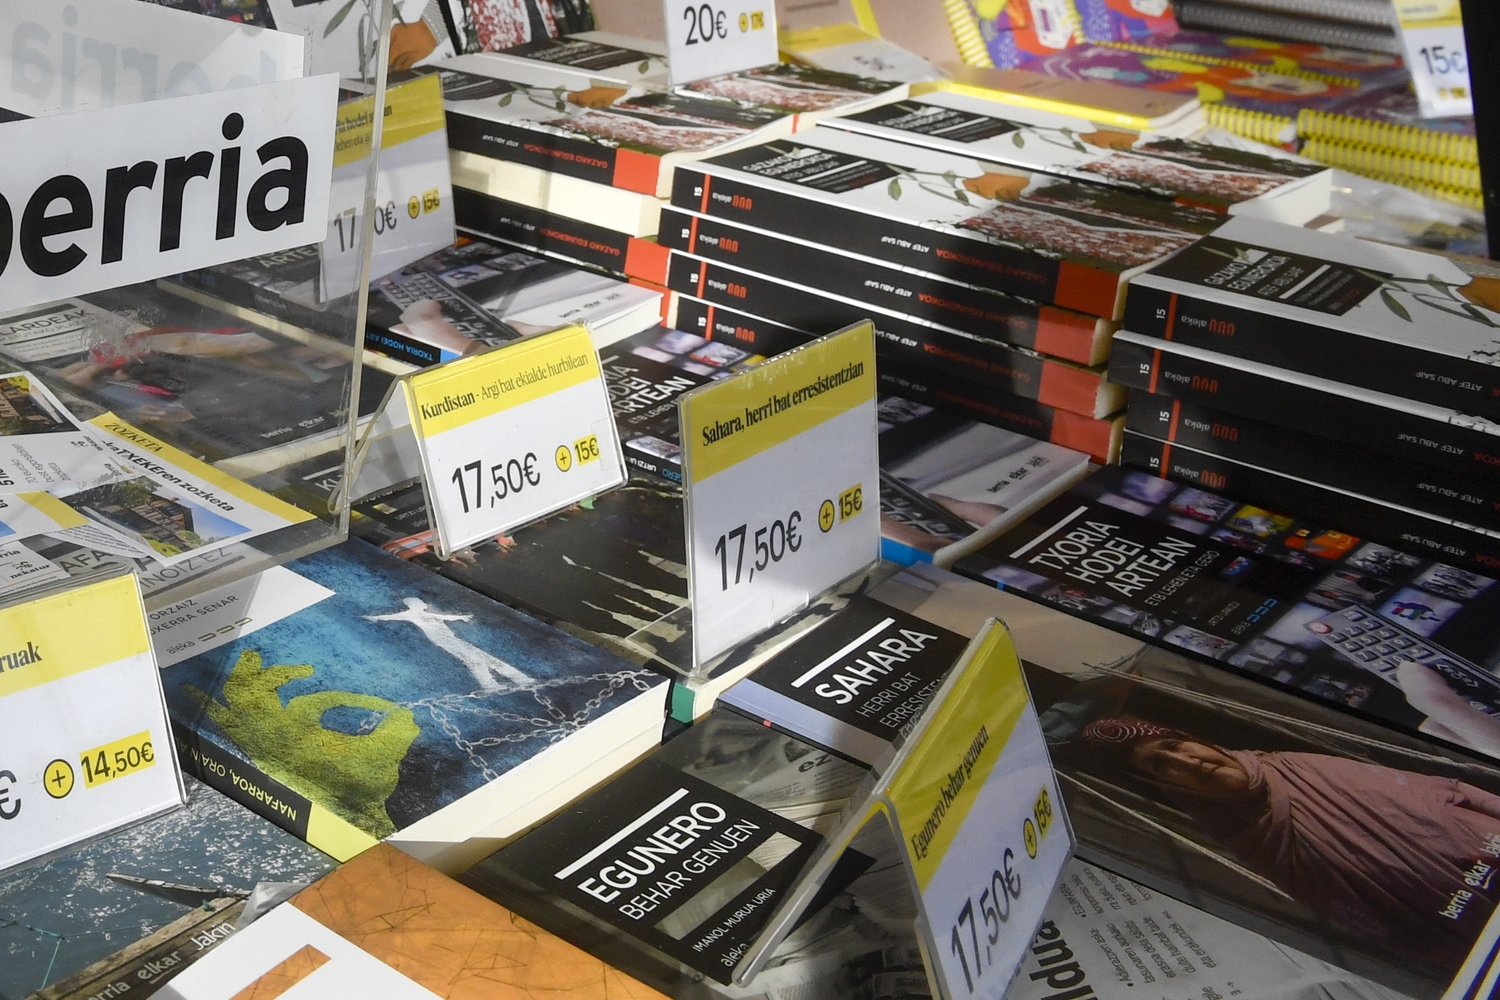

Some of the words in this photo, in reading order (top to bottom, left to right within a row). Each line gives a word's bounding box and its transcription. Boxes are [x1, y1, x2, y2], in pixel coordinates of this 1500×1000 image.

[683, 3, 728, 46] 20€
[1419, 46, 1469, 76] 15€
[576, 153, 609, 169] GAZAKO
[382, 334, 404, 351] HODEI
[1180, 315, 1208, 330] aleka
[405, 343, 434, 361] TXORIA
[420, 391, 477, 421] Kurdistan
[480, 381, 500, 401] Argi
[500, 377, 516, 394] bat
[515, 365, 548, 390] ekialde
[548, 353, 589, 378] hurbilean
[613, 375, 696, 418] ARTEAN
[1164, 370, 1191, 385] aleka
[1459, 380, 1483, 392] ATEF
[702, 415, 745, 448] Sahara,
[745, 398, 774, 430] herri
[774, 392, 792, 414] bat
[791, 361, 865, 408] erresistentzian
[104, 421, 164, 454] ZOZKETA
[178, 475, 236, 513] zozketa
[451, 452, 541, 514] 17,50€
[574, 437, 600, 463] 15€
[714, 510, 803, 592] 17,50€
[838, 487, 863, 521] 15€
[1029, 519, 1120, 573] TXORIA
[1065, 536, 1146, 586] HODEI
[10, 563, 51, 579] nekatur
[139, 557, 196, 594] INOIZ
[207, 545, 234, 563] EZ
[1106, 536, 1198, 600] ARTEAN
[1144, 589, 1167, 607] ETB
[1161, 574, 1190, 597] LEHEN
[1194, 550, 1221, 568] GERO
[148, 598, 198, 621] ORZAIZ
[196, 594, 241, 616] SENAR
[166, 640, 196, 655] aleka
[813, 625, 939, 707] SAHARA
[854, 684, 900, 720] HERRI
[895, 670, 923, 696] BAT
[80, 741, 155, 783] 14,50€
[189, 746, 227, 777] ORAIN
[229, 769, 297, 822] NAFARROA,
[910, 798, 947, 863] Egunero
[940, 770, 966, 810] behar
[961, 724, 991, 779] genuen
[576, 799, 728, 905] EGUNERO
[618, 867, 686, 922] BEHAR
[680, 817, 761, 876] GENUEN
[950, 847, 1022, 996] 17,50€
[1033, 789, 1053, 836] 15€
[1437, 888, 1474, 921] berria
[1466, 858, 1493, 890] elkar
[189, 920, 237, 952] Jakin
[690, 923, 731, 955] IMANOL
[724, 903, 760, 931] MURUA
[753, 886, 778, 909] URIA
[137, 948, 183, 983] elkar
[719, 941, 751, 968] aleka
